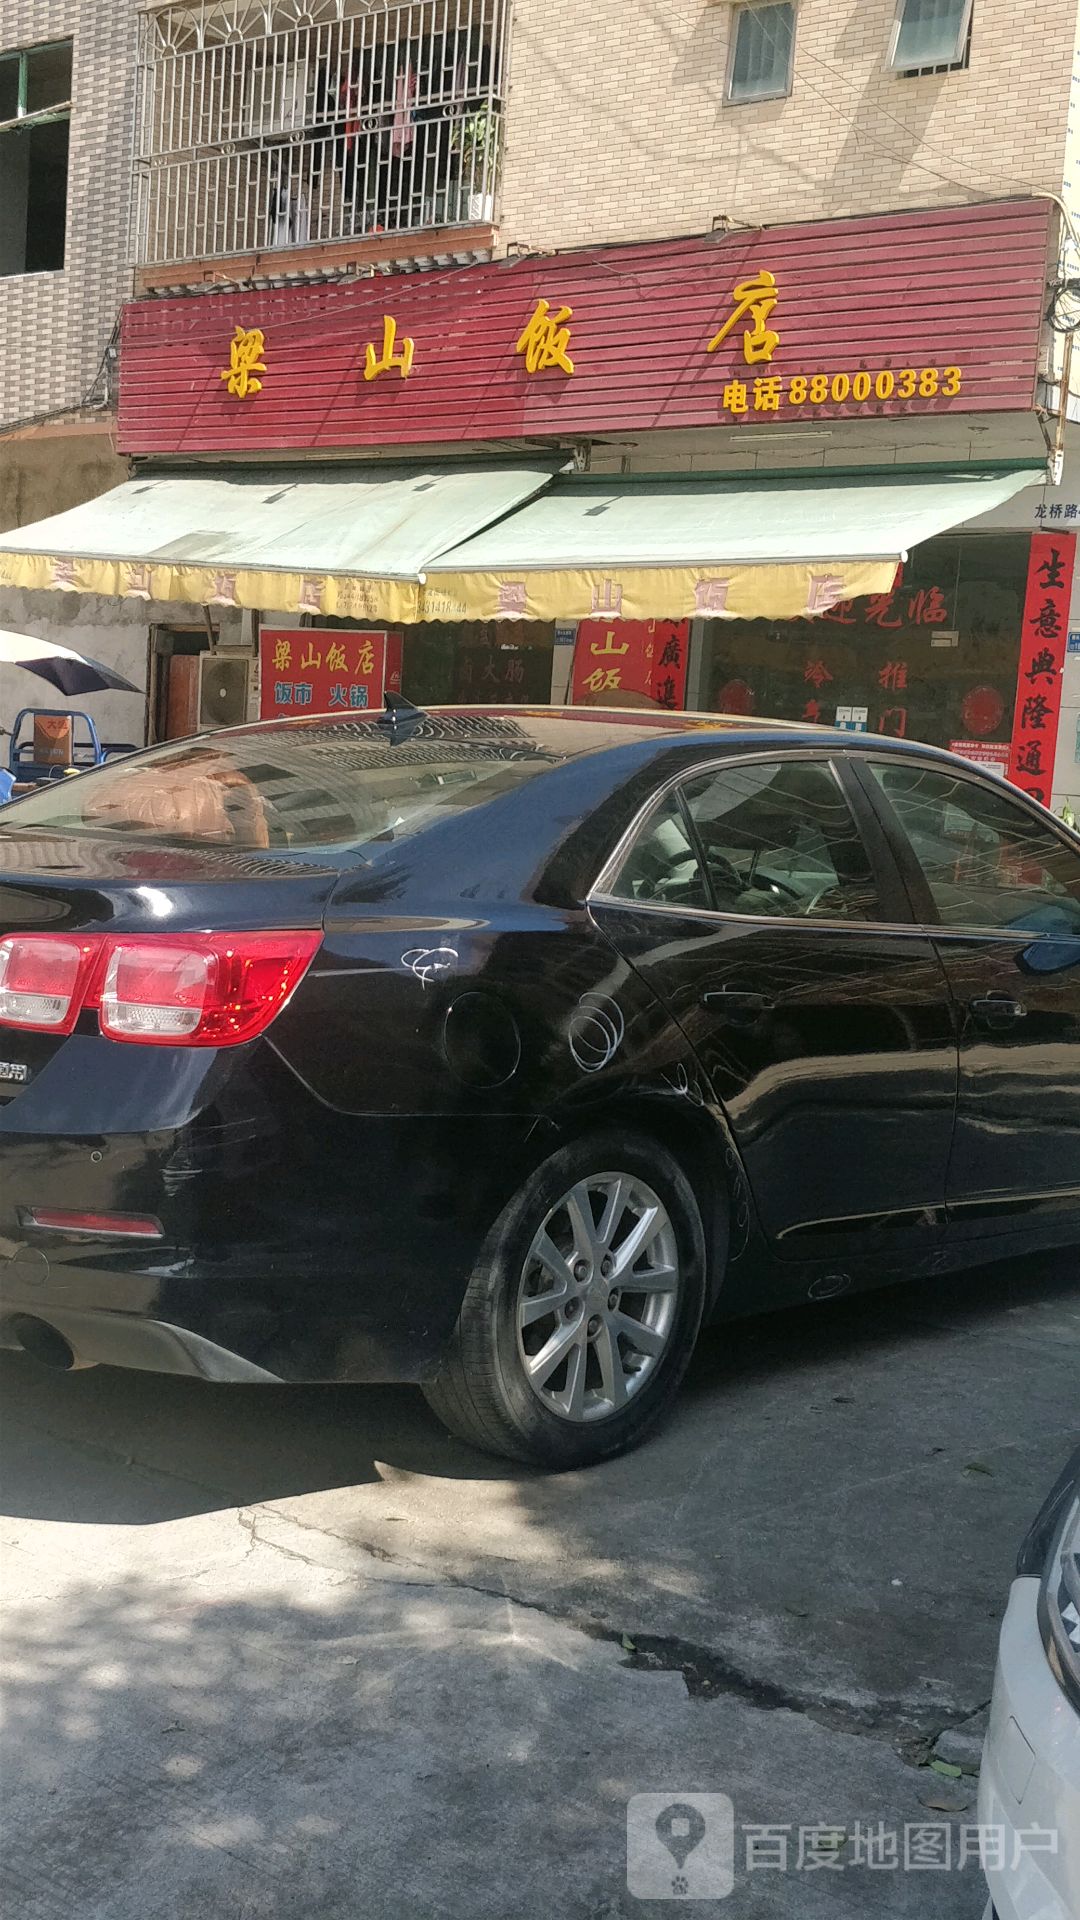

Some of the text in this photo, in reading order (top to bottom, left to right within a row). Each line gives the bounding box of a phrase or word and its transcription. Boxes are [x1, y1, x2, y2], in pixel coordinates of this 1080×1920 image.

[220, 269, 780, 399] 梁山饭店
[722, 366, 962, 413] 电话88000383
[272, 639, 376, 674] 梁山饭店
[274, 681, 369, 708] 饭市 火锅
